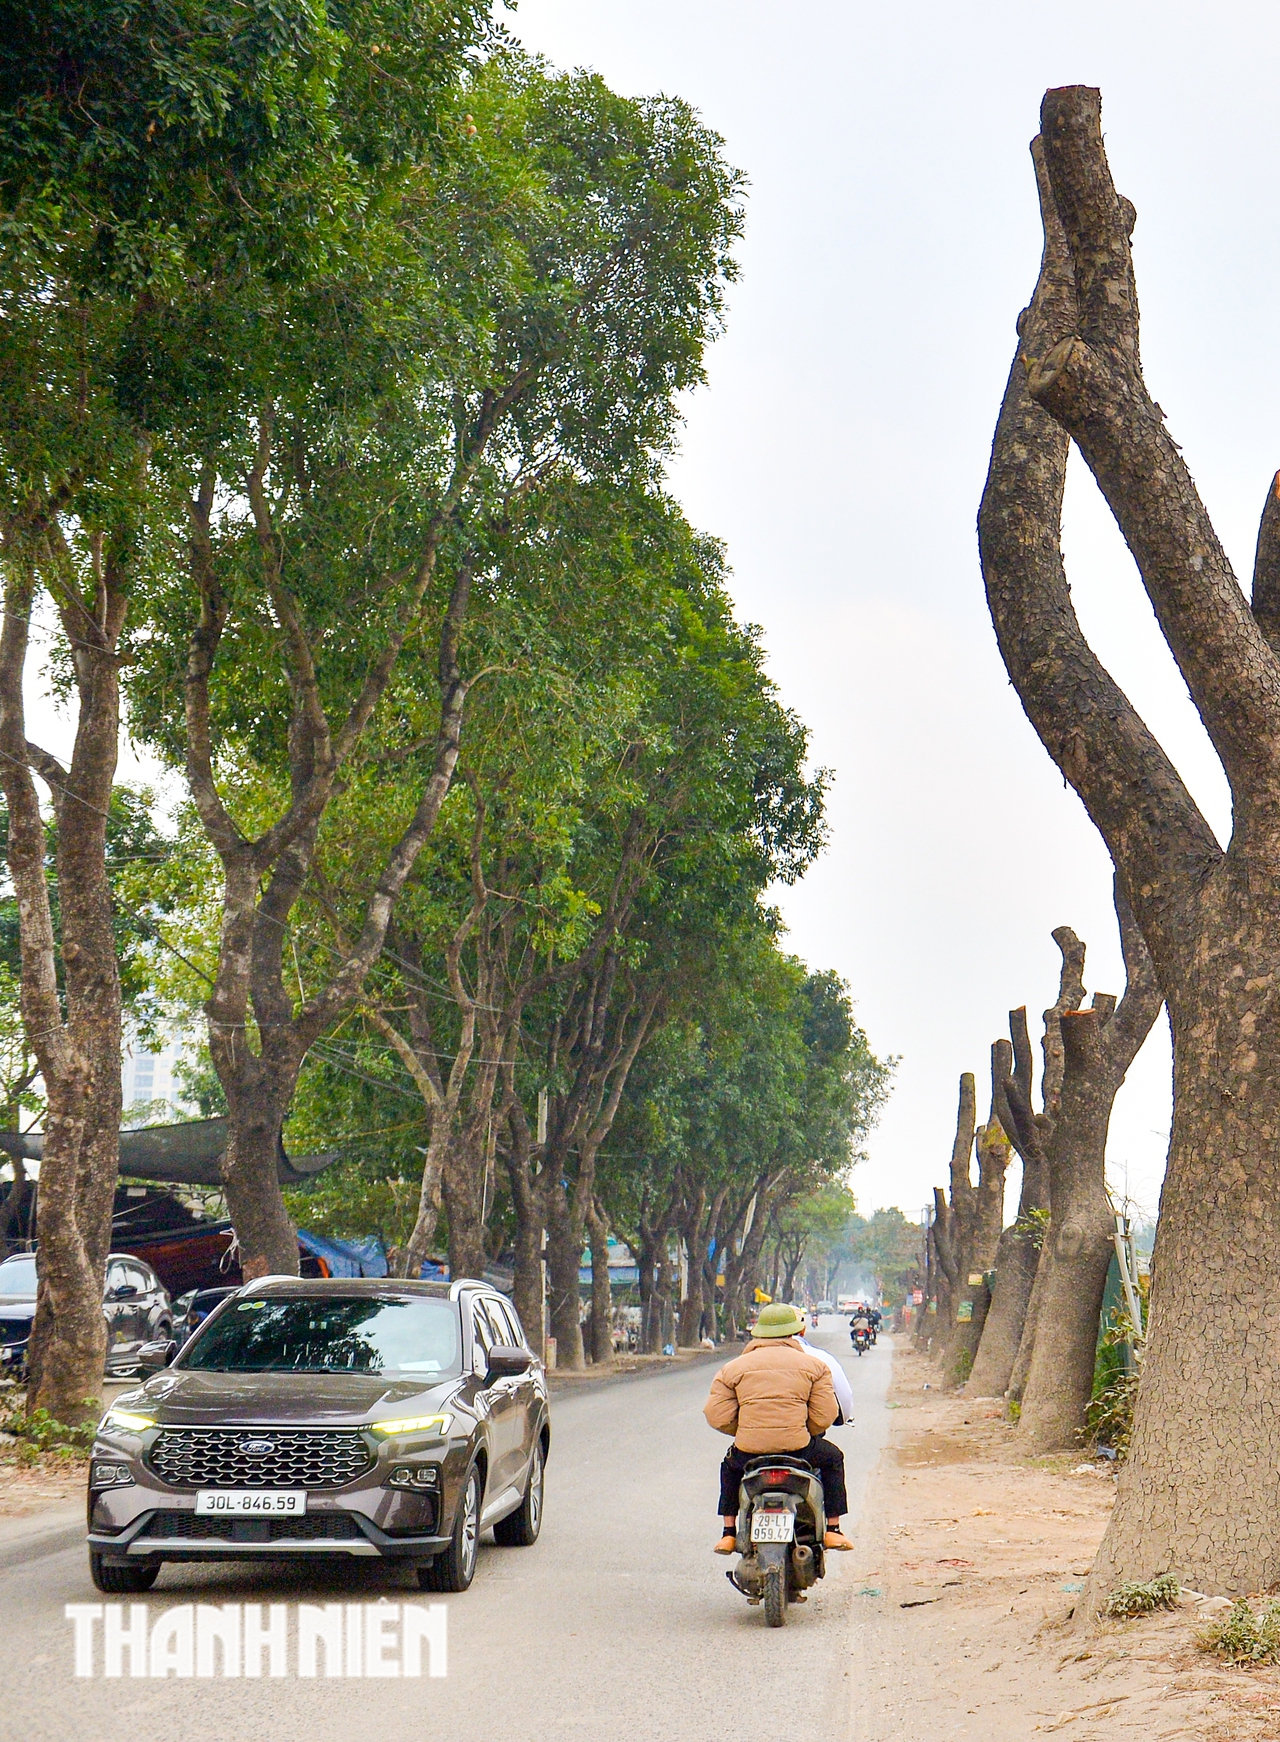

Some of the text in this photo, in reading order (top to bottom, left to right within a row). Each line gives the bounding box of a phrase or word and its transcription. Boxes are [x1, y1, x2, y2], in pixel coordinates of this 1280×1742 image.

[246, 1443, 267, 1452] Ford
[206, 1496, 296, 1510] 30L-846.59
[758, 1515, 787, 1527] 29-L1
[754, 1528, 790, 1540] 959.47
